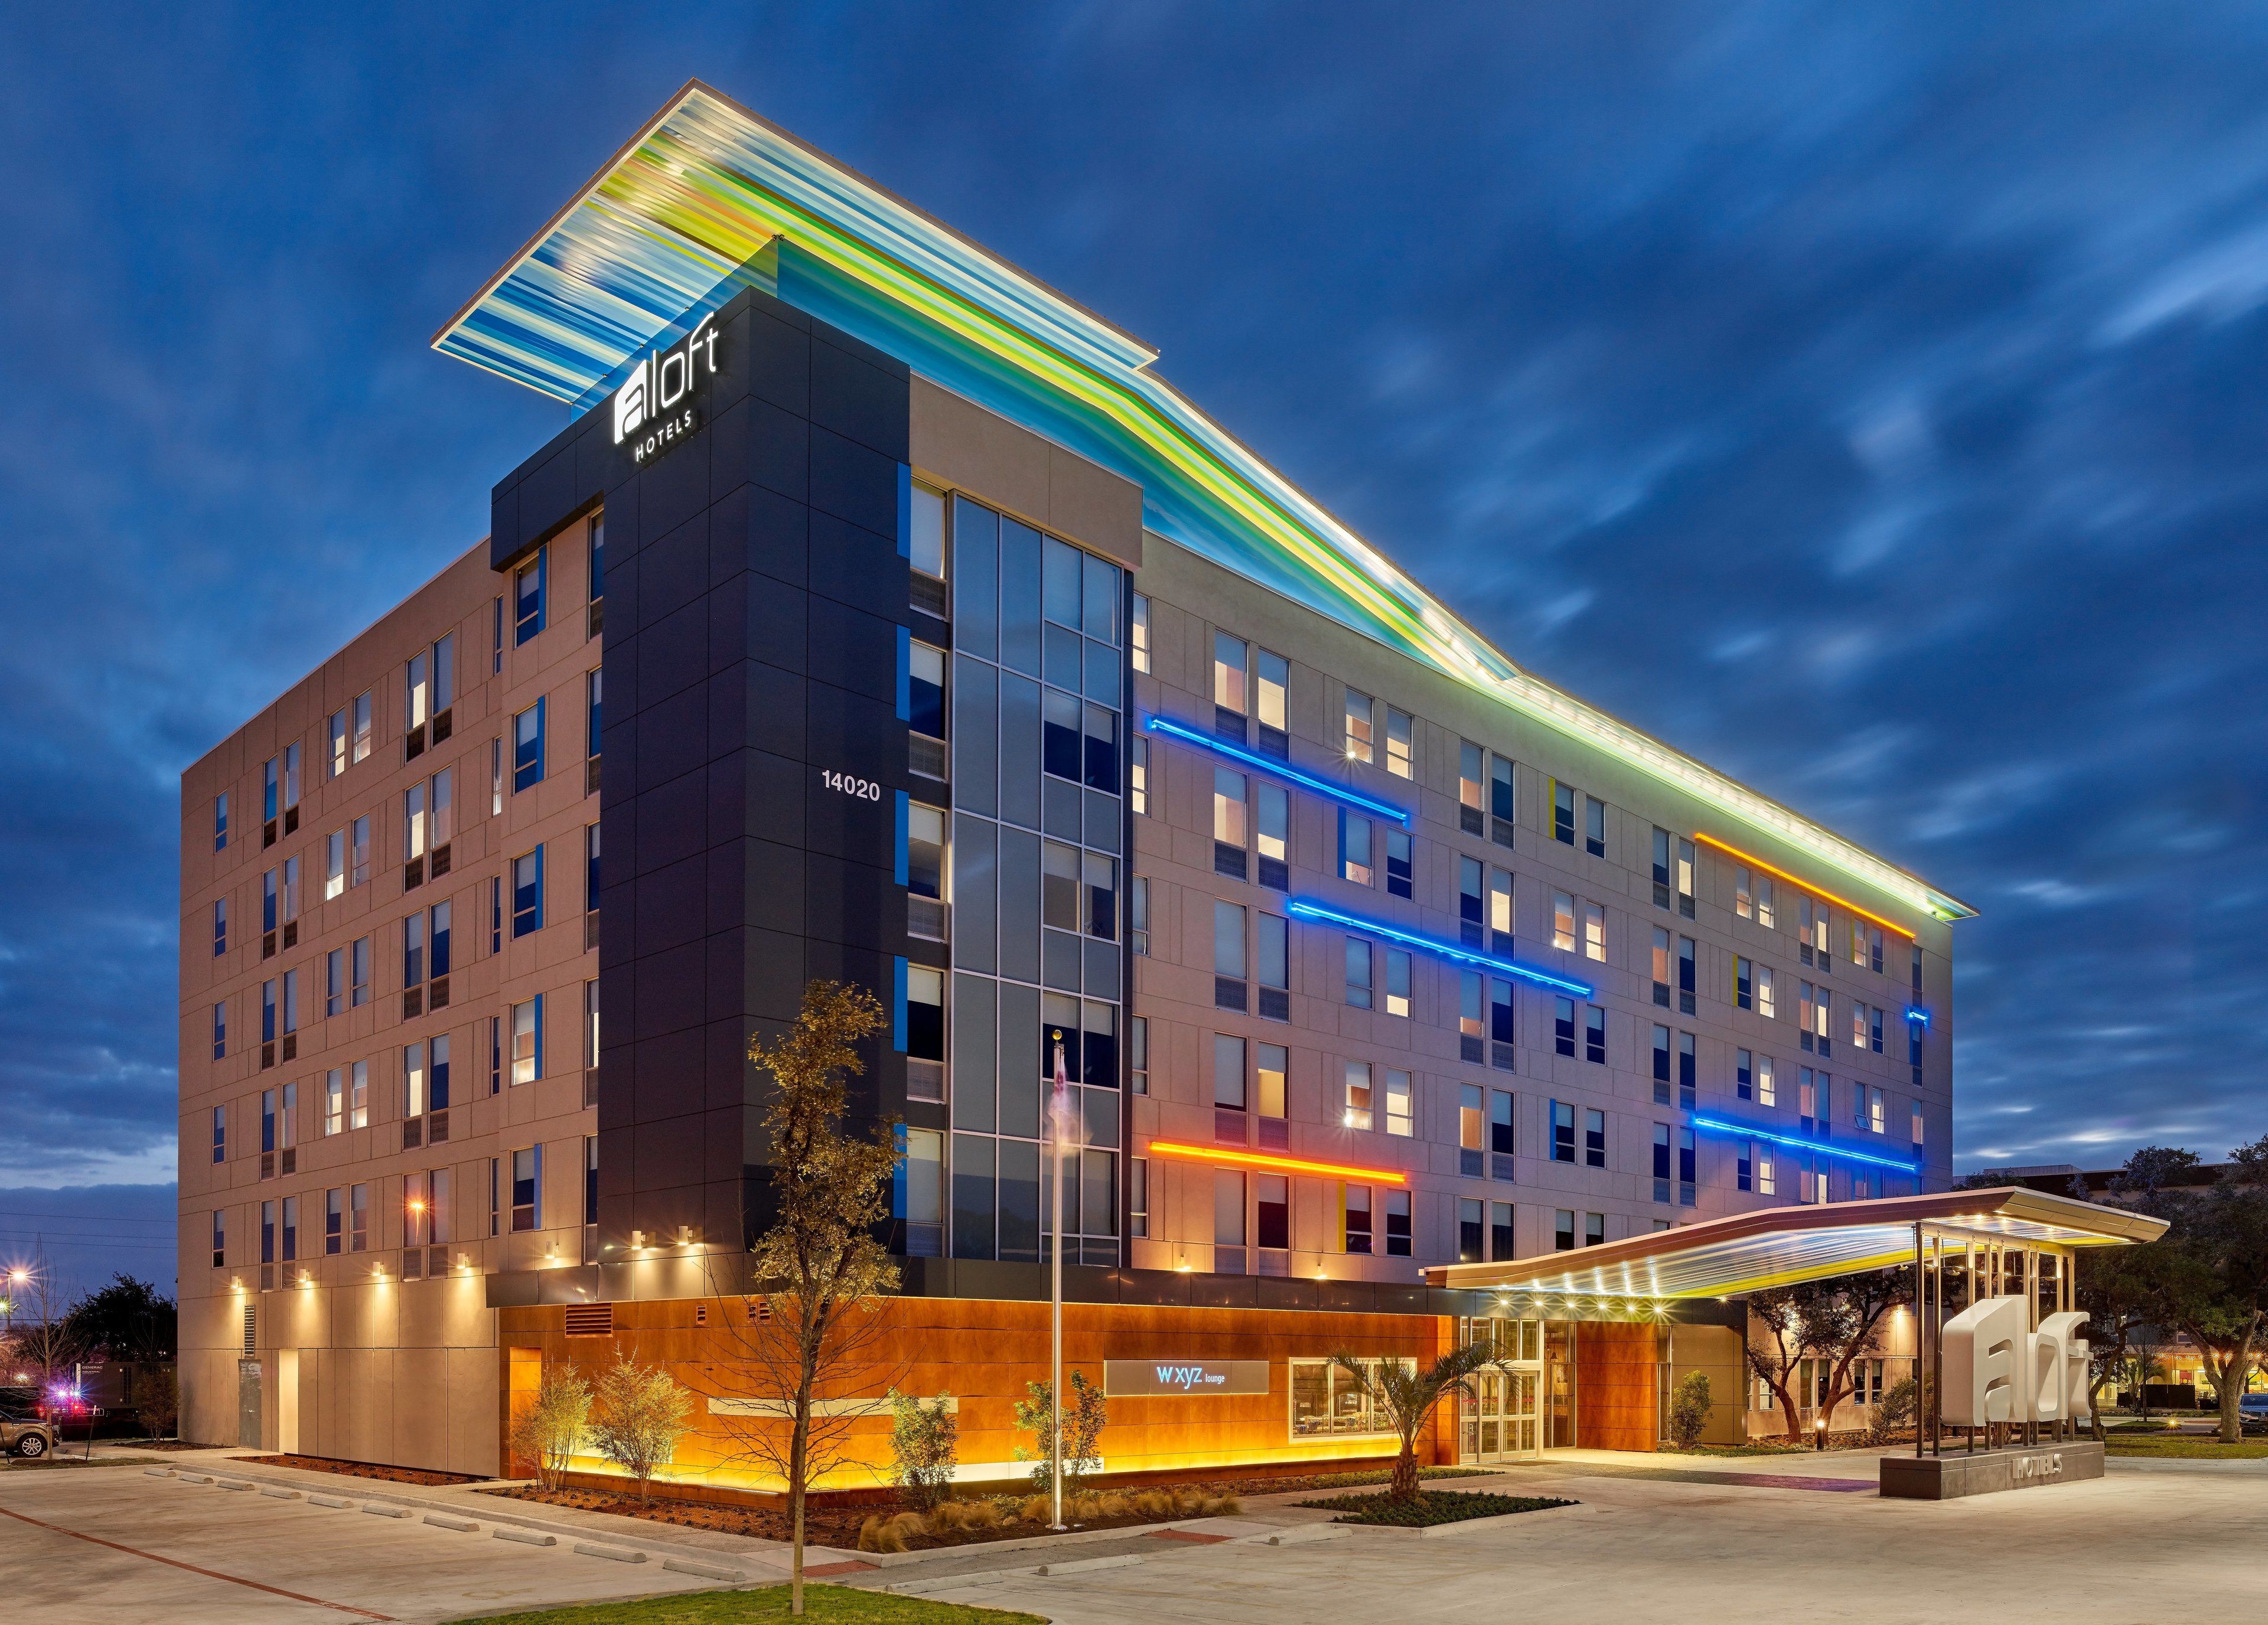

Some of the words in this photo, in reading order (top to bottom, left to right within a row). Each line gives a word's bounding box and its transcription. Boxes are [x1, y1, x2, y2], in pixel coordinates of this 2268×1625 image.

[614, 311, 718, 444] aloft
[636, 410, 691, 462] HOTELS
[822, 769, 881, 801] 14020
[1205, 1373, 1225, 1384] lounge
[1942, 1294, 2094, 1427] aloft
[2012, 1453, 2062, 1479] HOTELS
